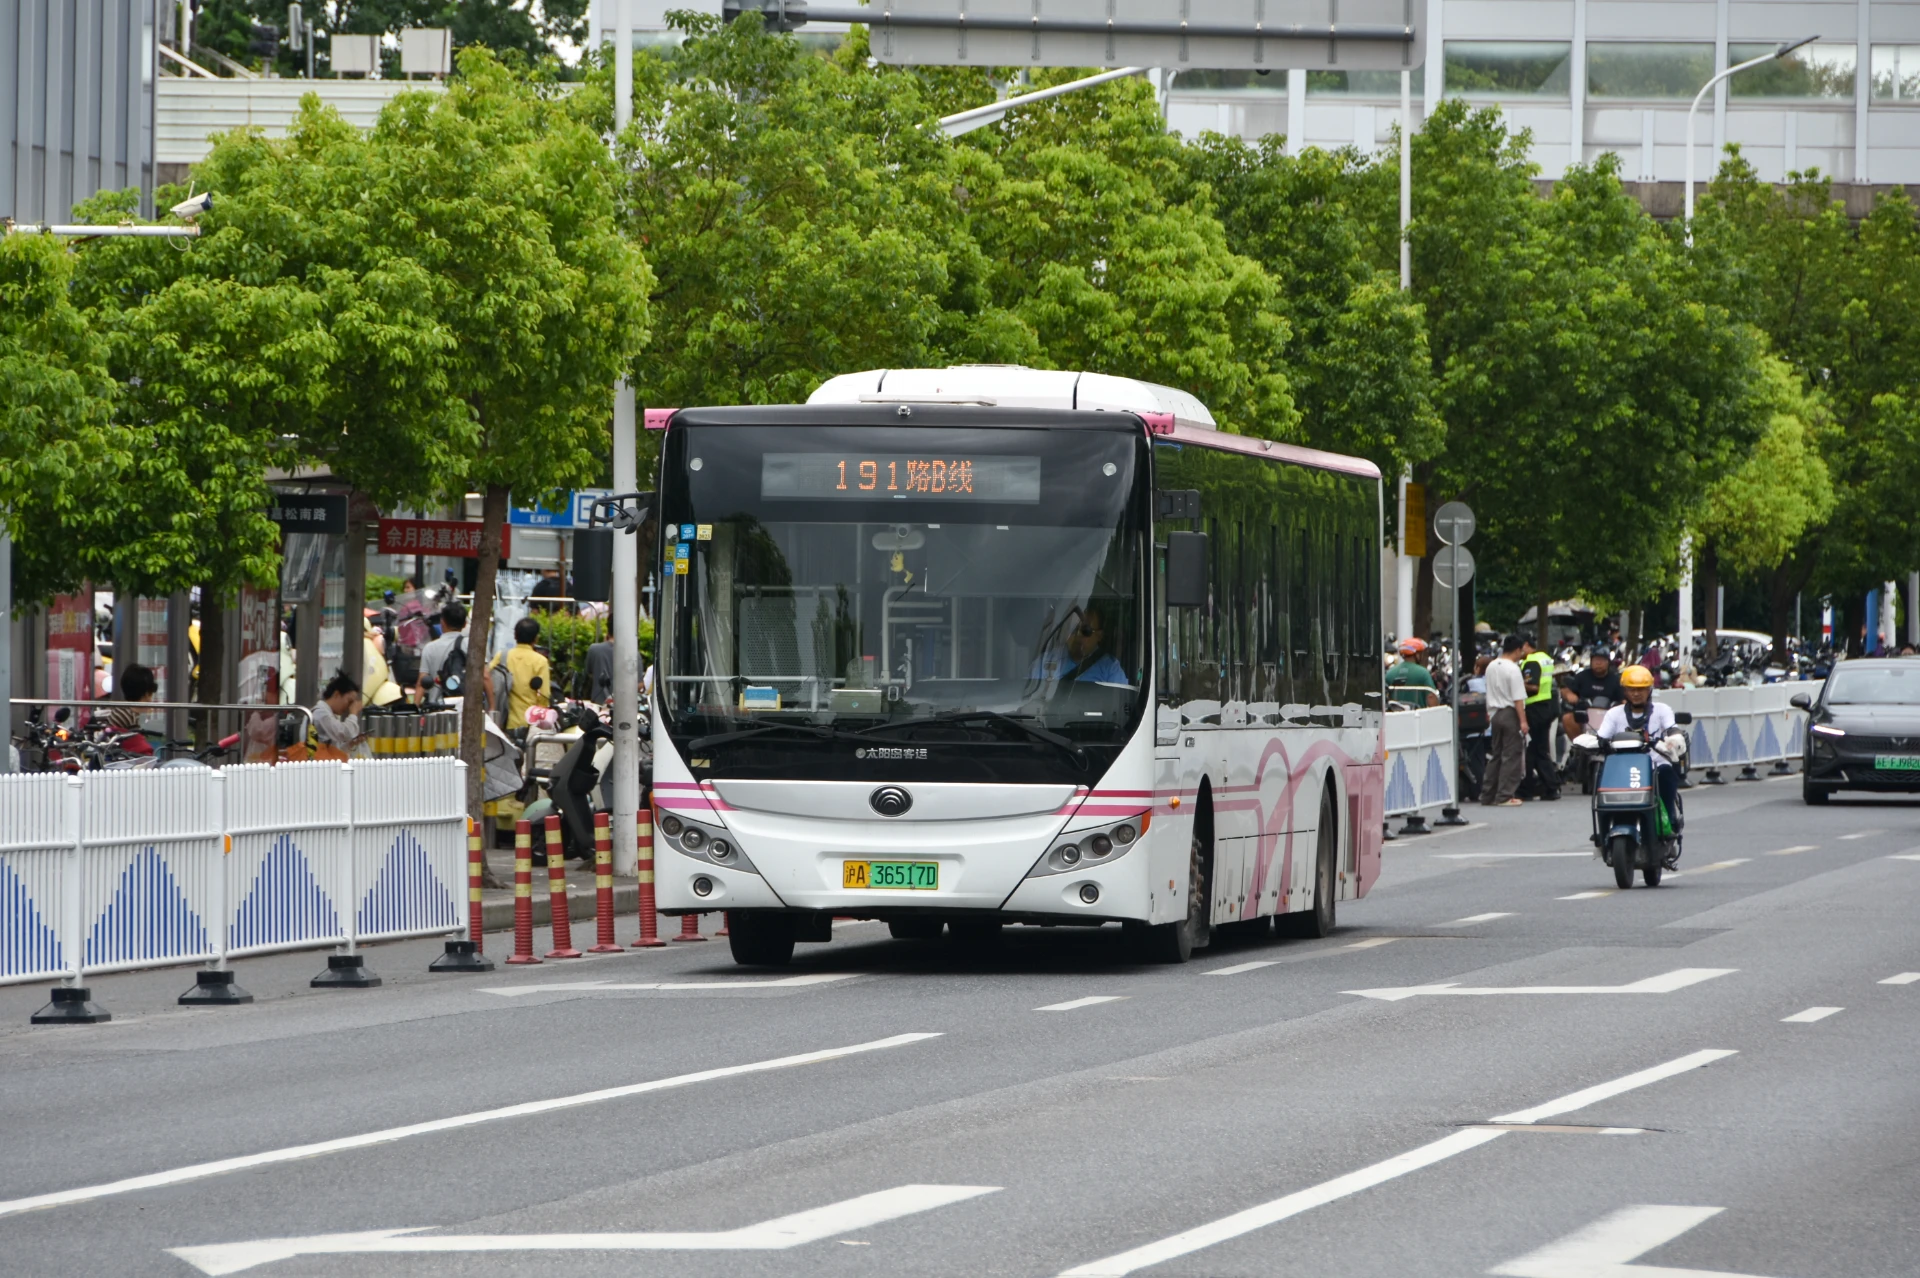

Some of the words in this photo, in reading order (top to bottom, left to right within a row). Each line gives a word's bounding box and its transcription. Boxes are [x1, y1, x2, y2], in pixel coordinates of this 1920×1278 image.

[836, 460, 973, 493] 191路B线
[529, 514, 552, 524] EXIT
[386, 526, 483, 550] 佘月路嘉松南
[866, 747, 928, 760] 太阳岛客运
[1629, 766, 1642, 789] SUP
[874, 865, 936, 886] 36517D
